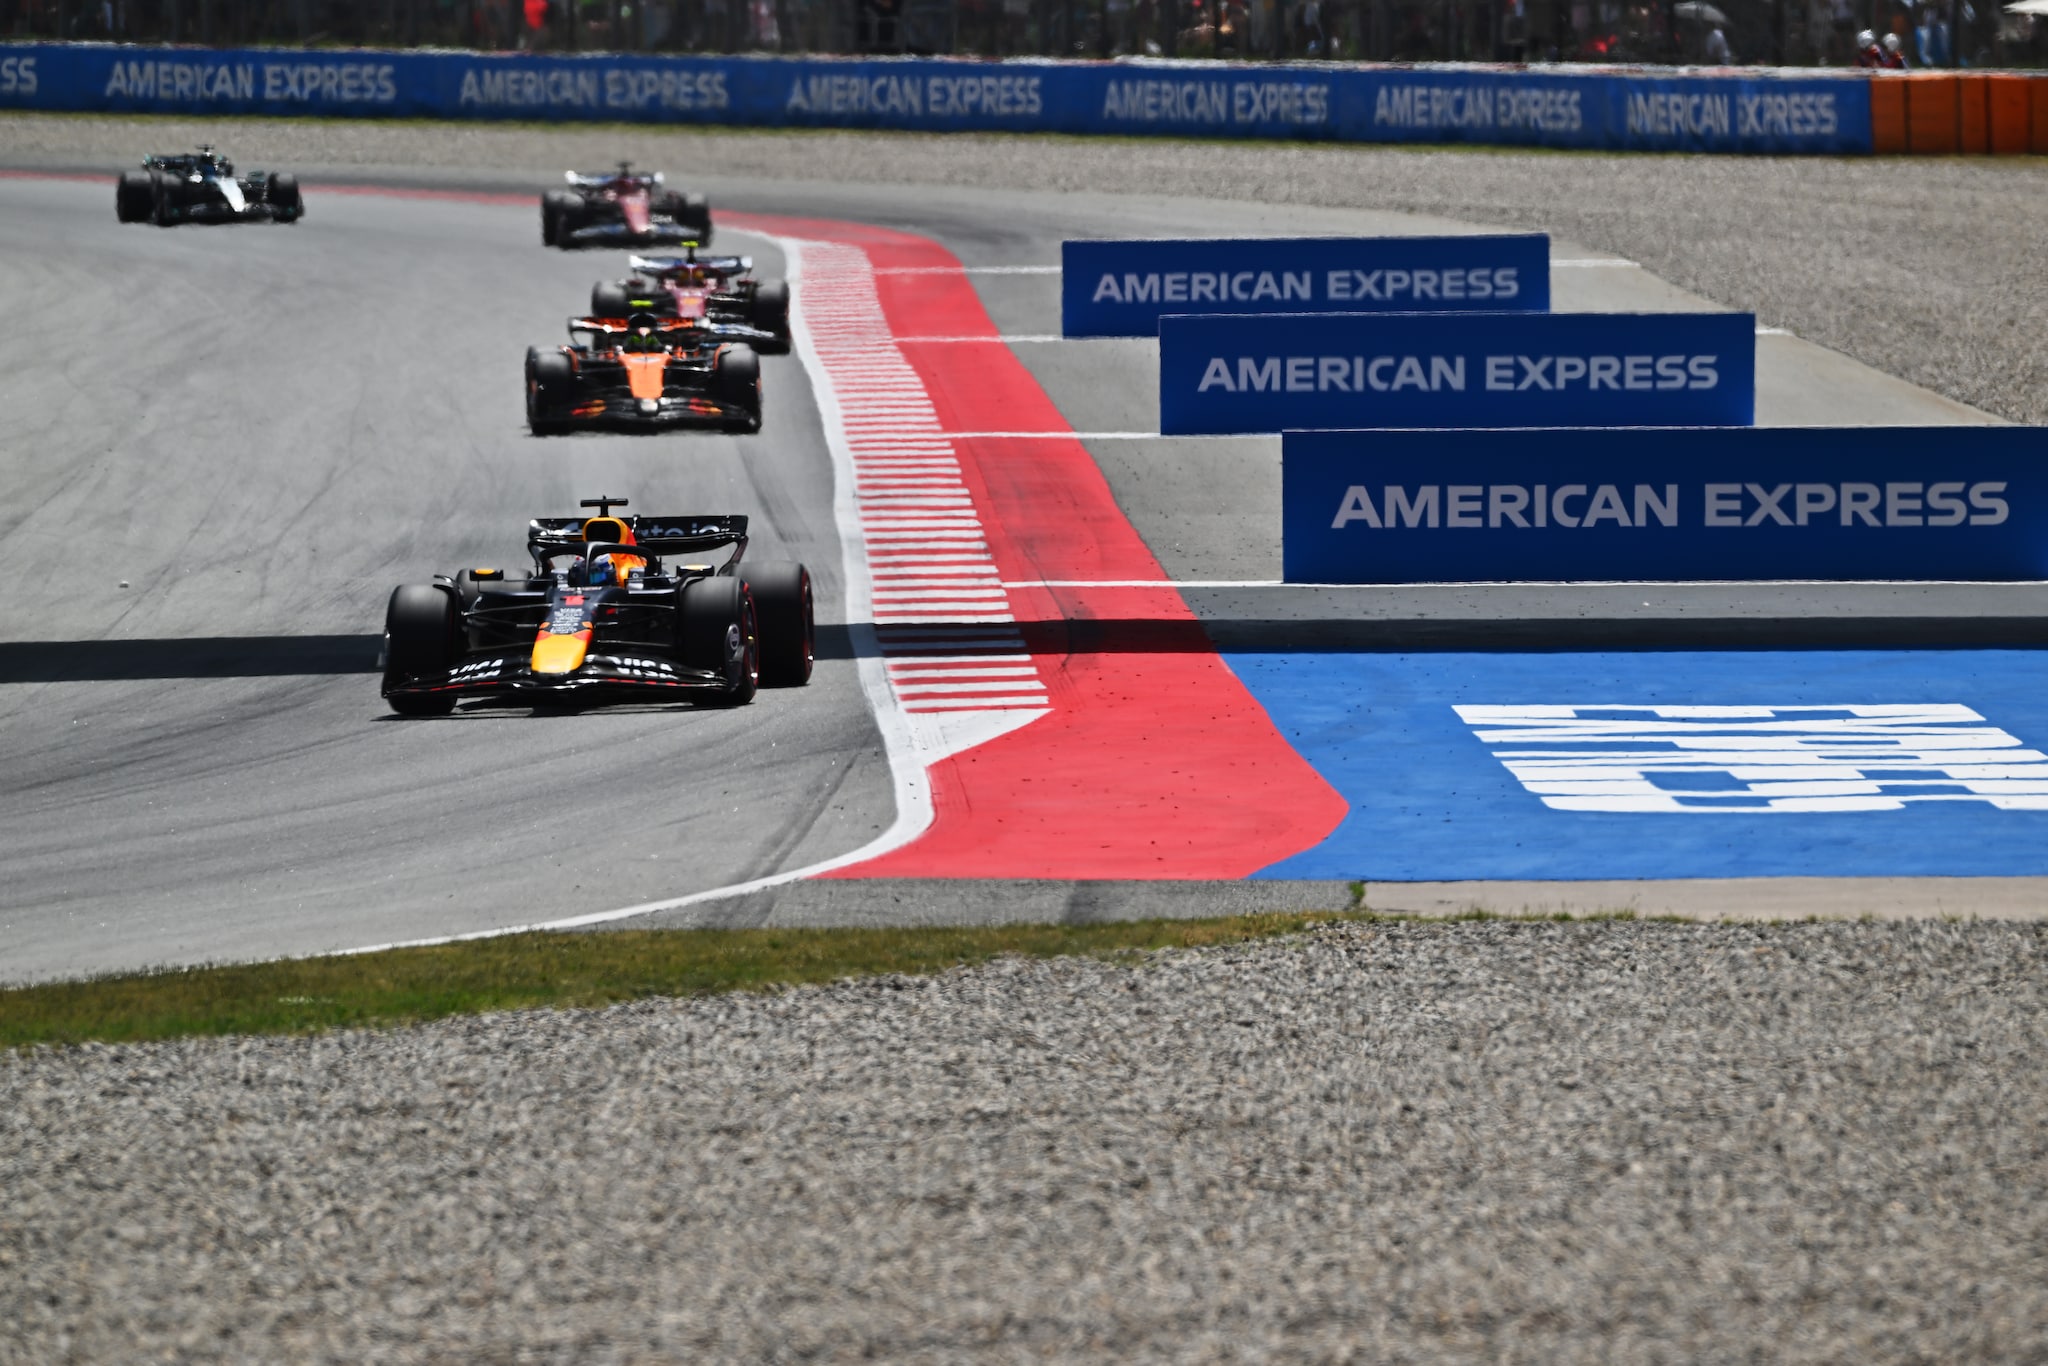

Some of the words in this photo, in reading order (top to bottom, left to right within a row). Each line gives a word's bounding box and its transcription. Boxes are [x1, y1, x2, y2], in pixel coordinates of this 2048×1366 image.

[105, 61, 254, 98] AMERICAN
[263, 64, 397, 100] EXPRESS
[460, 70, 599, 105] AMERICAN
[605, 70, 729, 108] EXPRESS
[787, 75, 923, 114] AMERICAN
[928, 76, 1042, 115] EXPRESS
[1104, 80, 1228, 121] AMERICAN
[1234, 82, 1328, 122] EXPRESS
[1374, 86, 1493, 127] AMERICAN
[1497, 88, 1582, 130] EXPRESS
[1093, 272, 1312, 302] AMERICAN
[1327, 268, 1519, 300] EXPRESS
[1198, 356, 1466, 392] AMERICAN
[1485, 355, 1719, 391] EXPRESS
[1331, 484, 1679, 529] AMERICAN
[1704, 481, 2010, 527] EXPRESS
